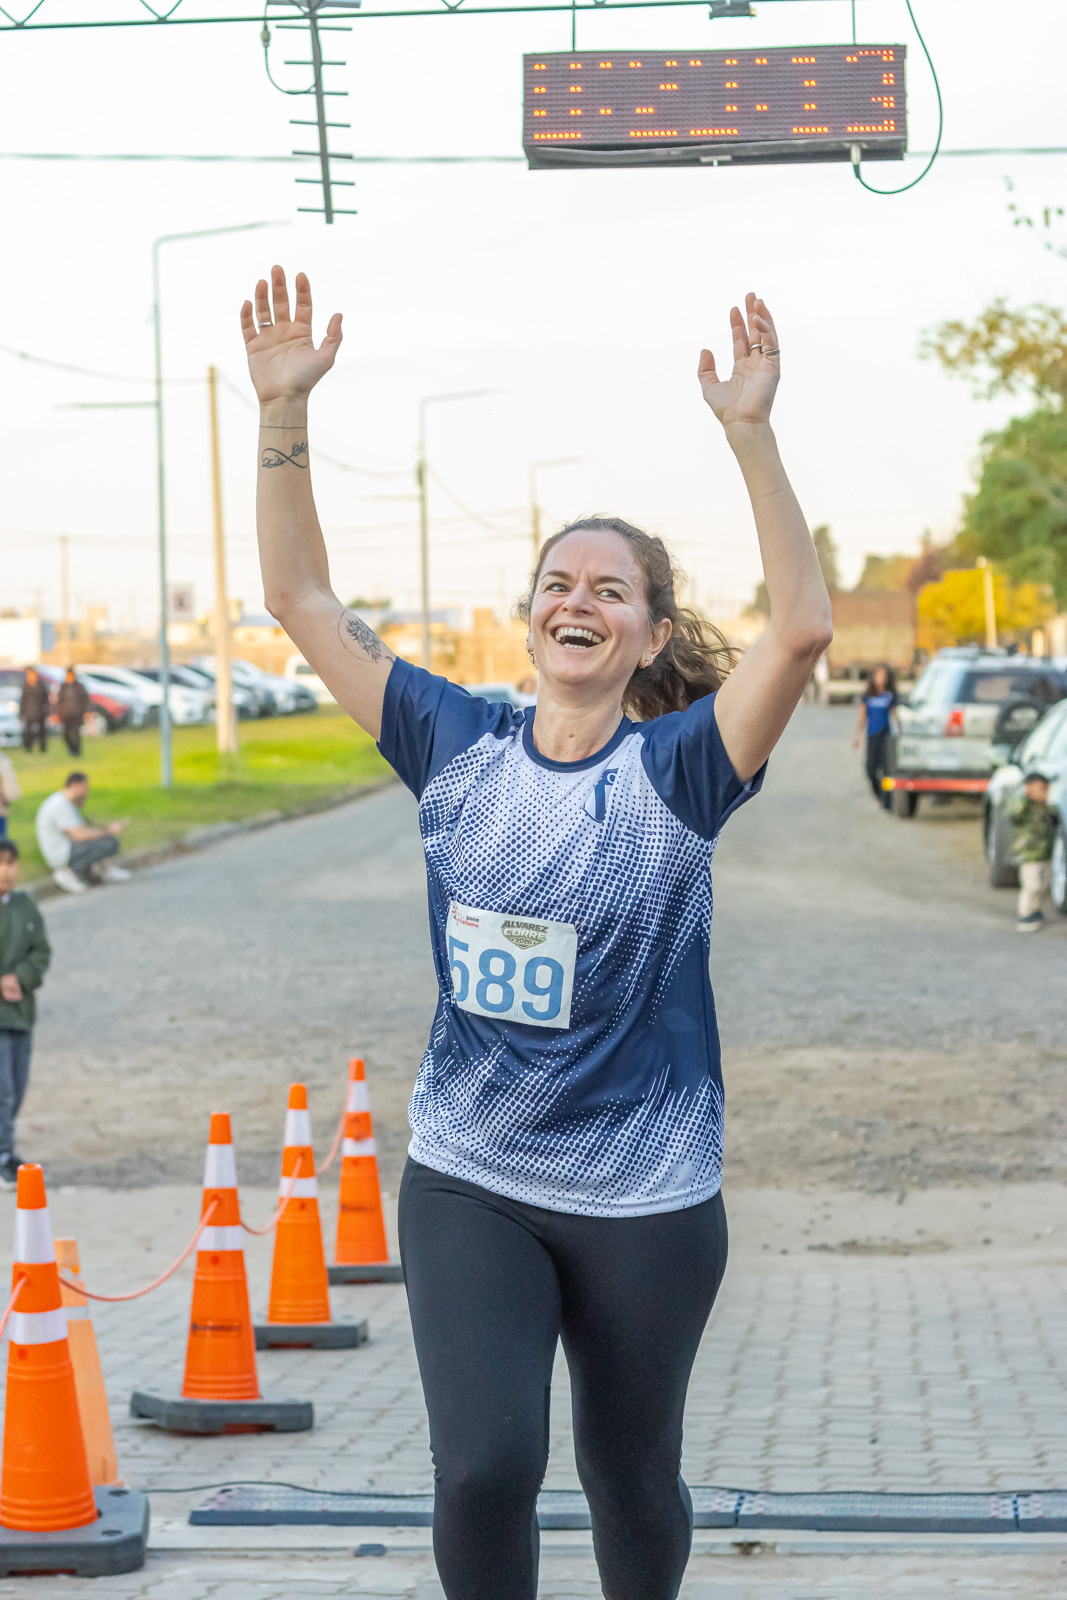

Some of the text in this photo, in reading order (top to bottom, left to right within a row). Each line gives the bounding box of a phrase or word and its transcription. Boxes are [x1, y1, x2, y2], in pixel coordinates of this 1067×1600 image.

[501, 919, 549, 934] ALVAREZ
[503, 927, 547, 941] CORRE
[449, 935, 564, 1021] 589
